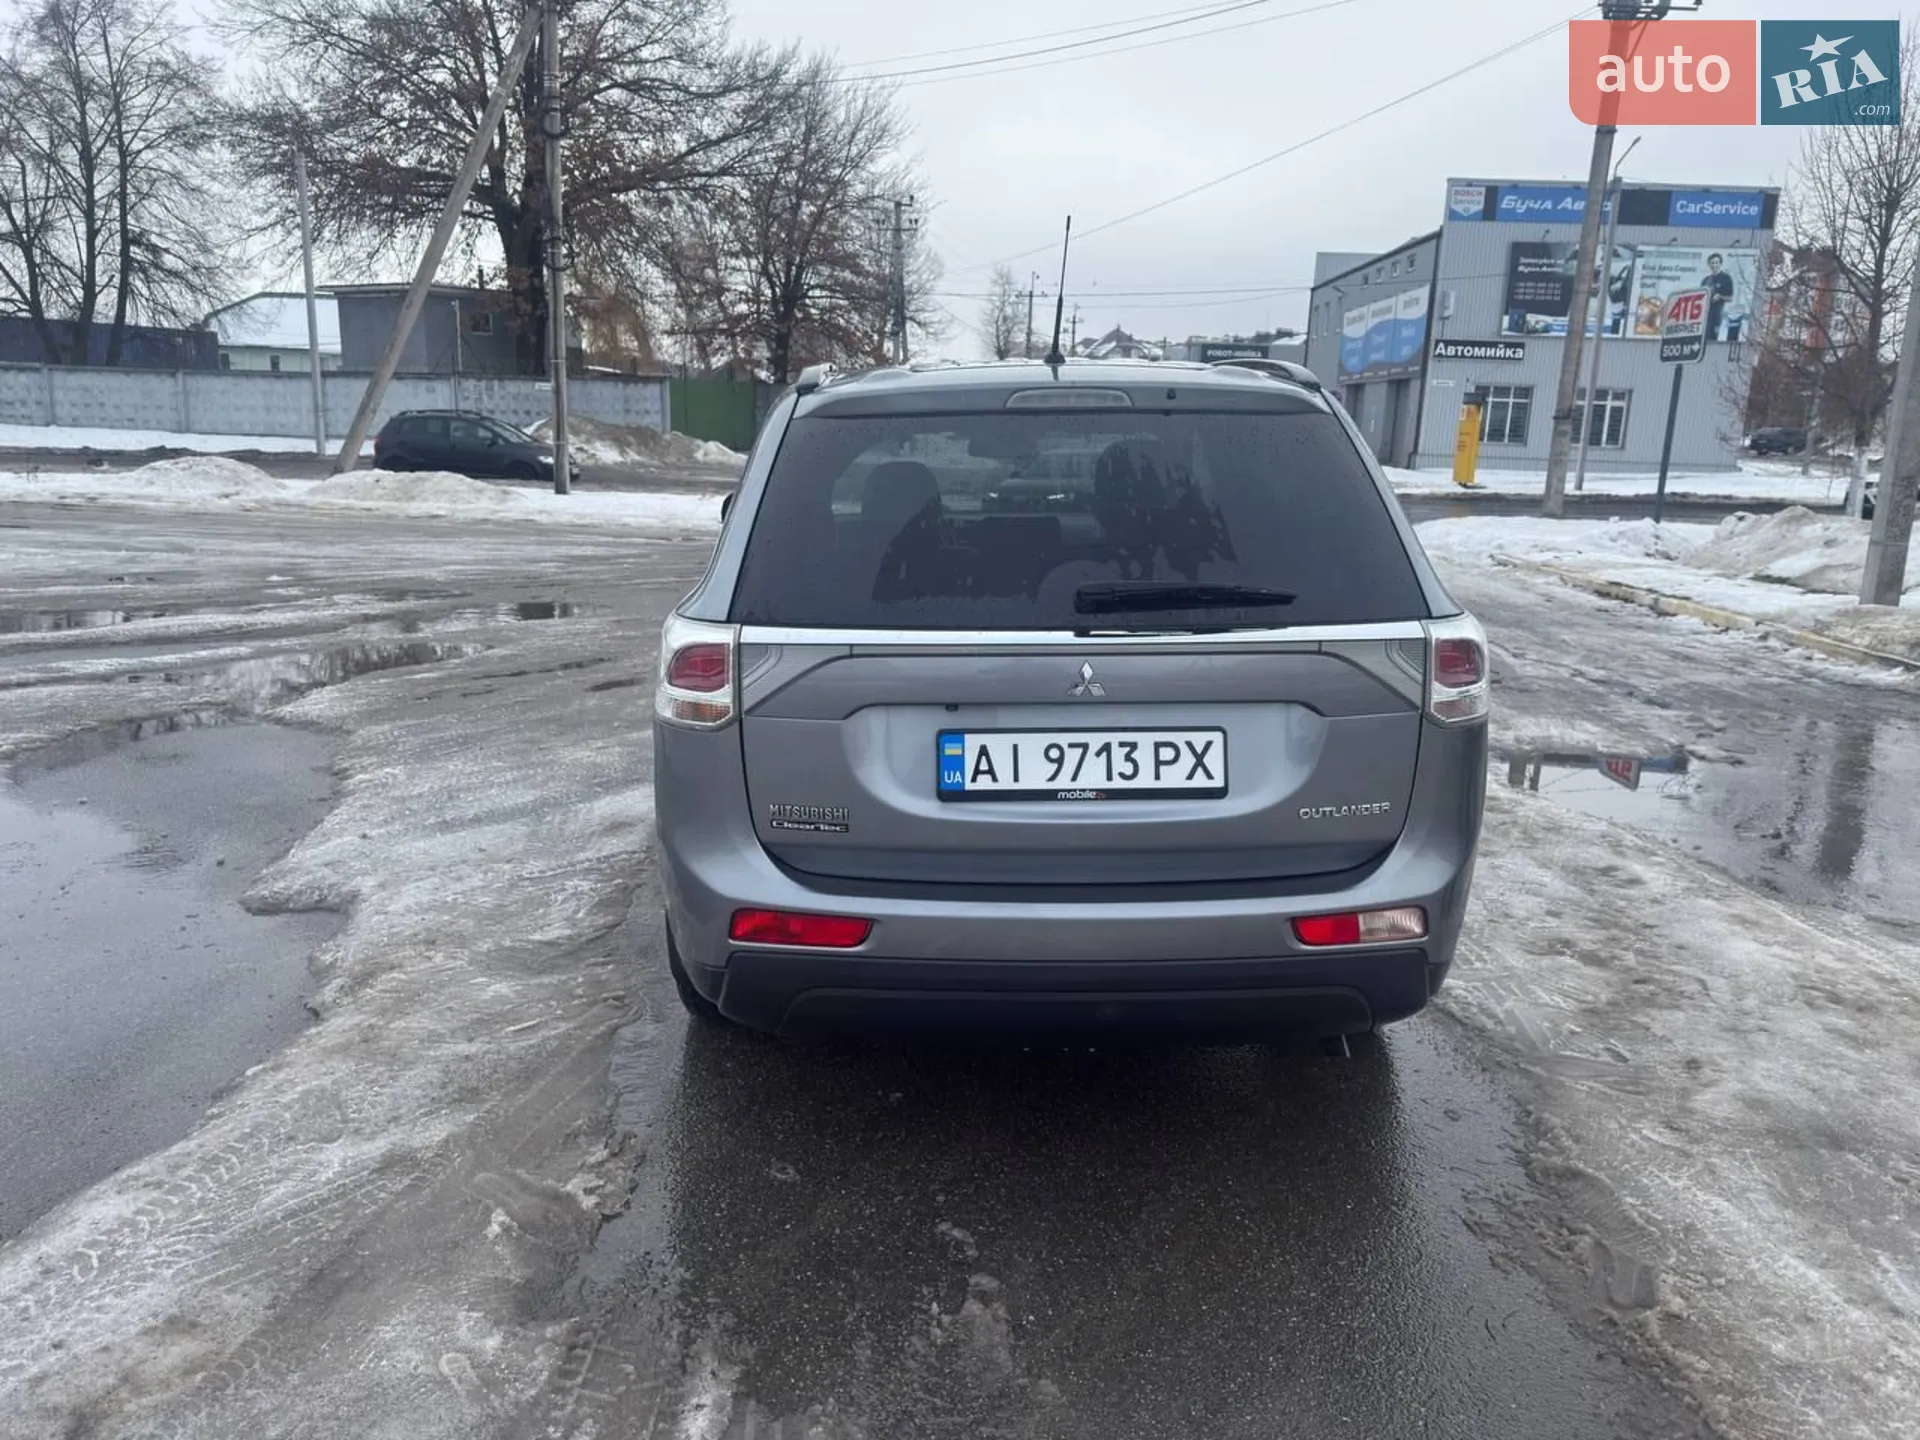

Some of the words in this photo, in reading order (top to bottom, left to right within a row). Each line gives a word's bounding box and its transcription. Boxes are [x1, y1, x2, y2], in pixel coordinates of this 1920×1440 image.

[1557, 196, 1613, 212] Аво
[1676, 200, 1758, 216] CarService
[1668, 292, 1705, 322] АТБ
[1434, 341, 1524, 359] Автомийка
[1662, 344, 1681, 357] 500
[944, 771, 962, 784] UA
[970, 743, 1019, 783] AI
[1043, 741, 1140, 782] 9713
[1153, 740, 1214, 781] PX
[770, 804, 849, 821] MITSUBISHI
[1299, 801, 1390, 819] OUTLANDER
